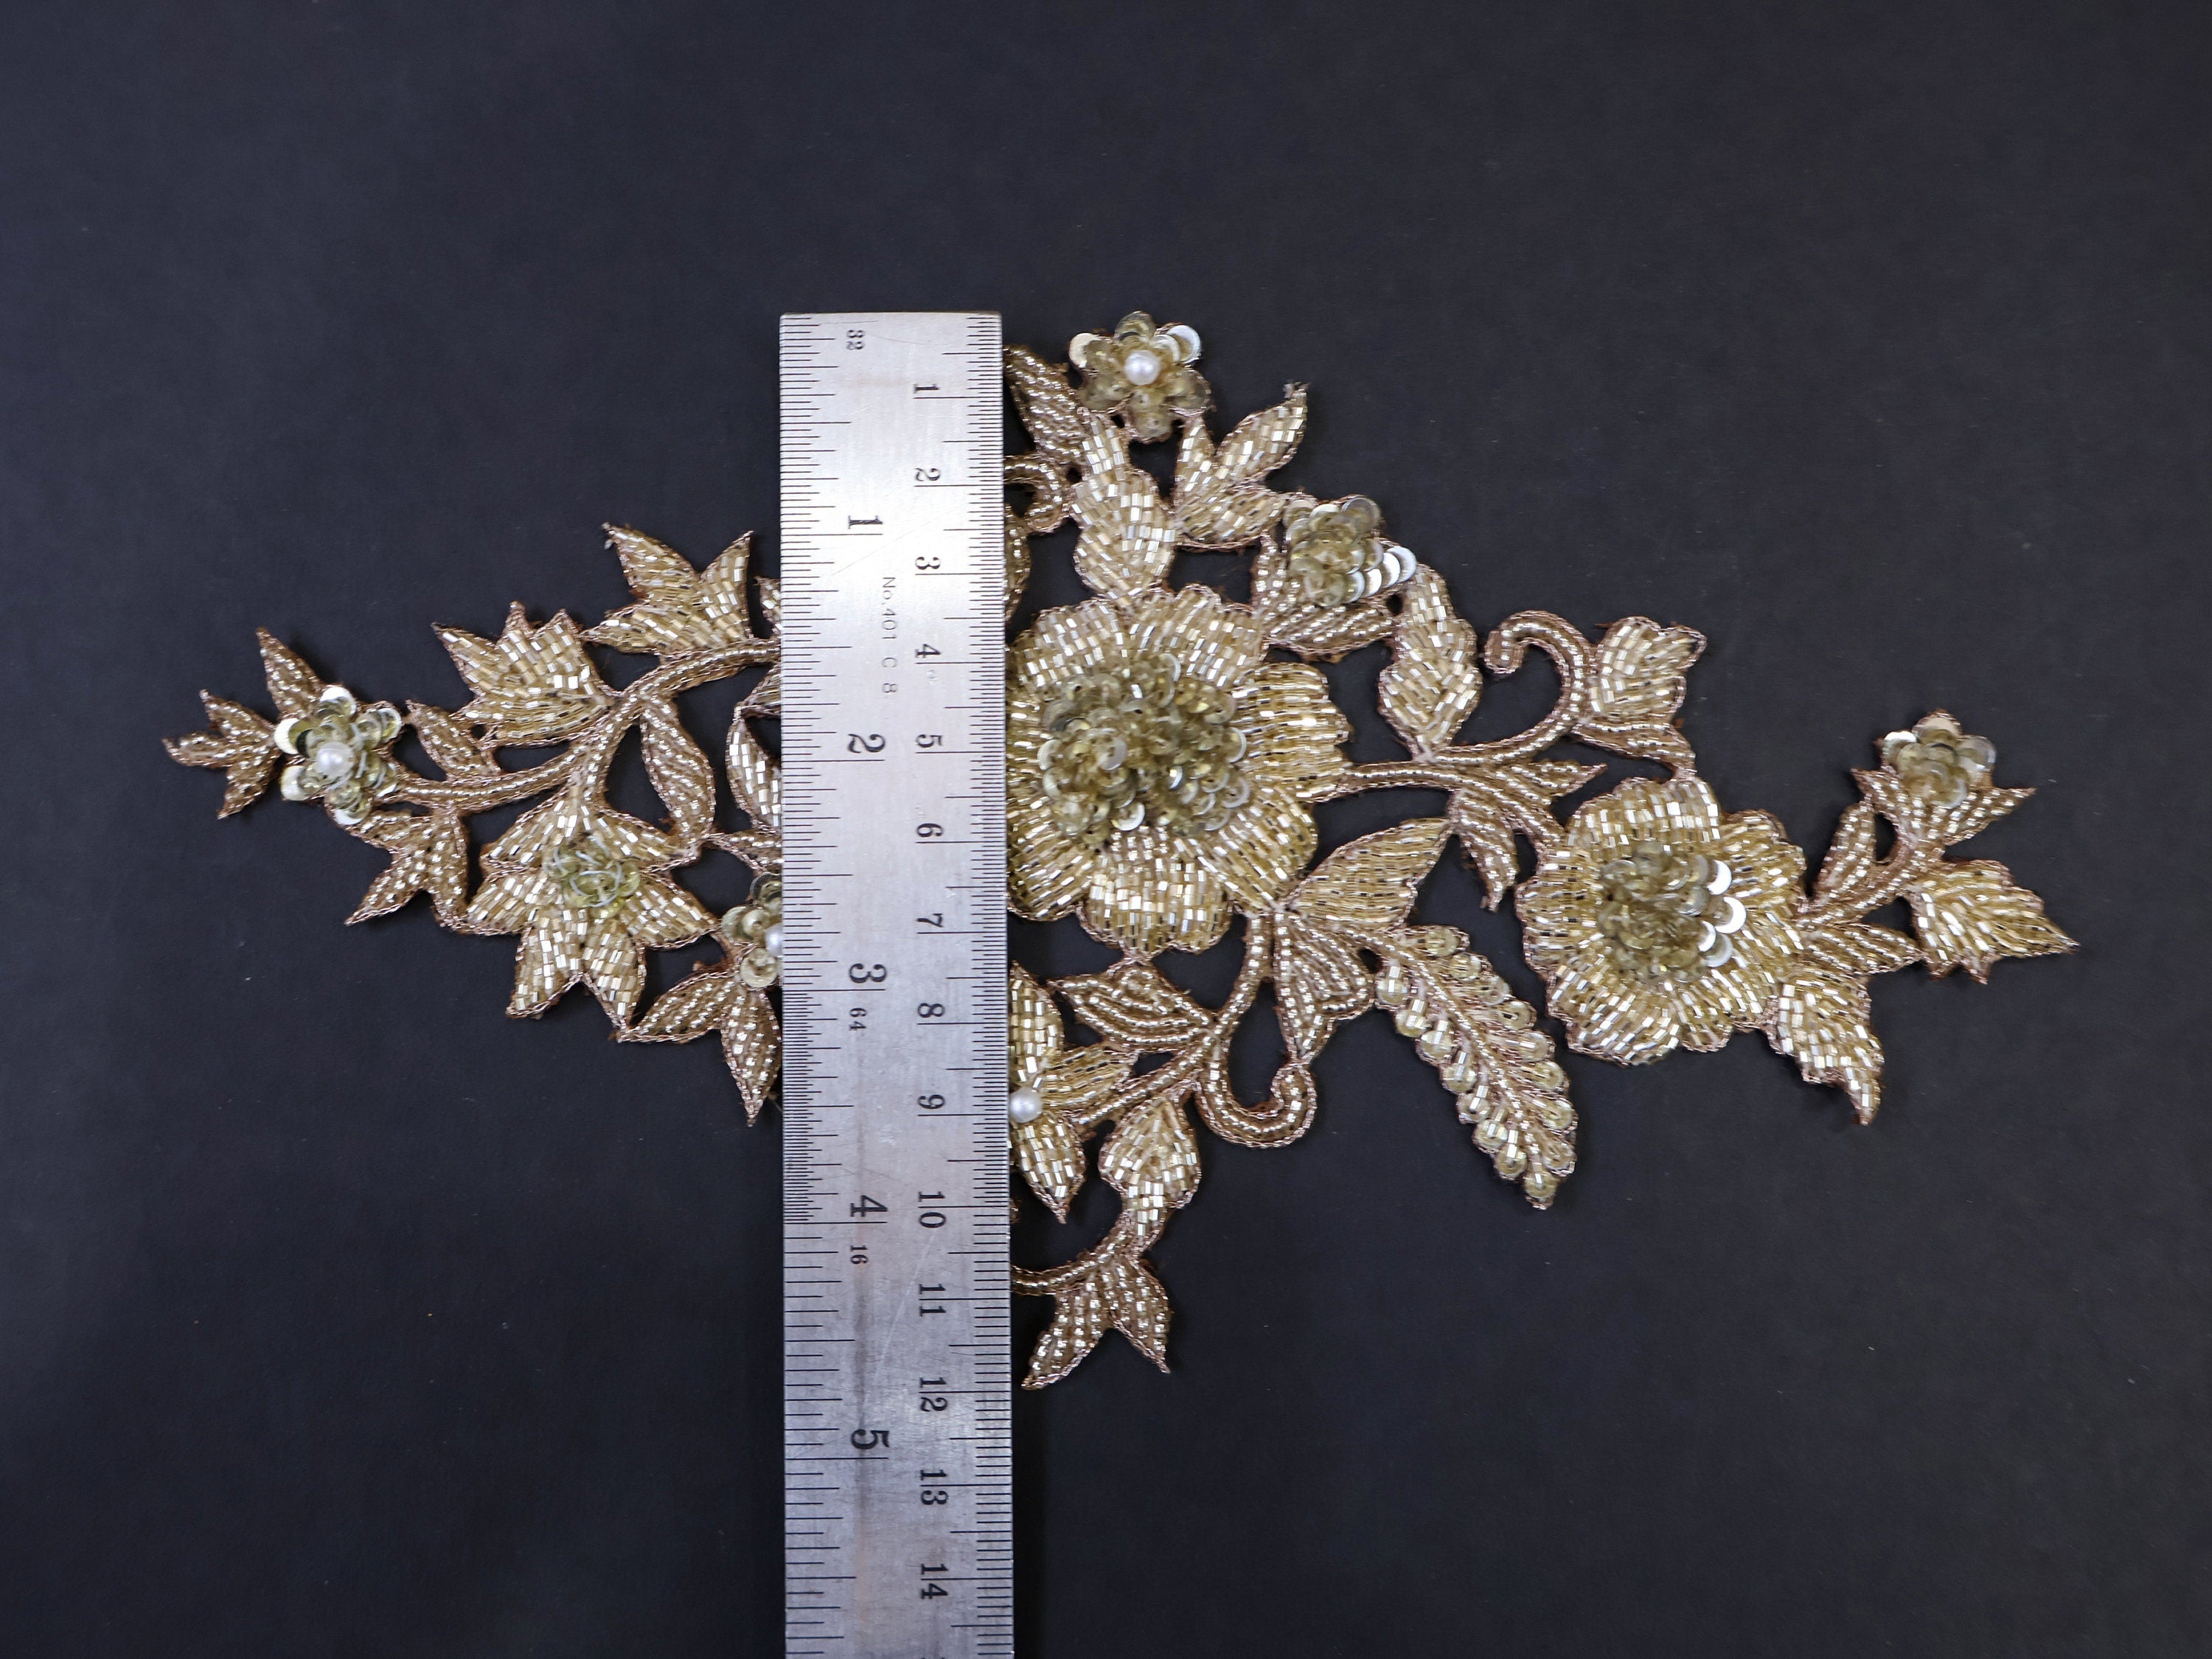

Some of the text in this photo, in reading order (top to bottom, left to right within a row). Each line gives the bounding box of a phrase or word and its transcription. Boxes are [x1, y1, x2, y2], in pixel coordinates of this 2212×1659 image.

[914, 383, 939, 394] 1
[914, 468, 940, 481] 2
[848, 515, 883, 529] 1
[915, 557, 941, 569] 3
[916, 644, 942, 658] 4
[848, 734, 886, 754] 2
[916, 734, 943, 748] 5
[917, 823, 944, 838] 6
[917, 913, 944, 928] 7
[849, 963, 888, 984] 3
[849, 1007, 866, 1032] 64
[918, 1003, 945, 1018] 8
[918, 1094, 945, 1110] 9
[850, 1195, 888, 1217] 4
[918, 1191, 946, 1228] 10
[850, 1245, 869, 1265] 16
[919, 1283, 946, 1317] 11
[919, 1377, 947, 1412] 12
[851, 1429, 890, 1450] 5
[920, 1470, 949, 1505] 13
[921, 1563, 949, 1599] 14
